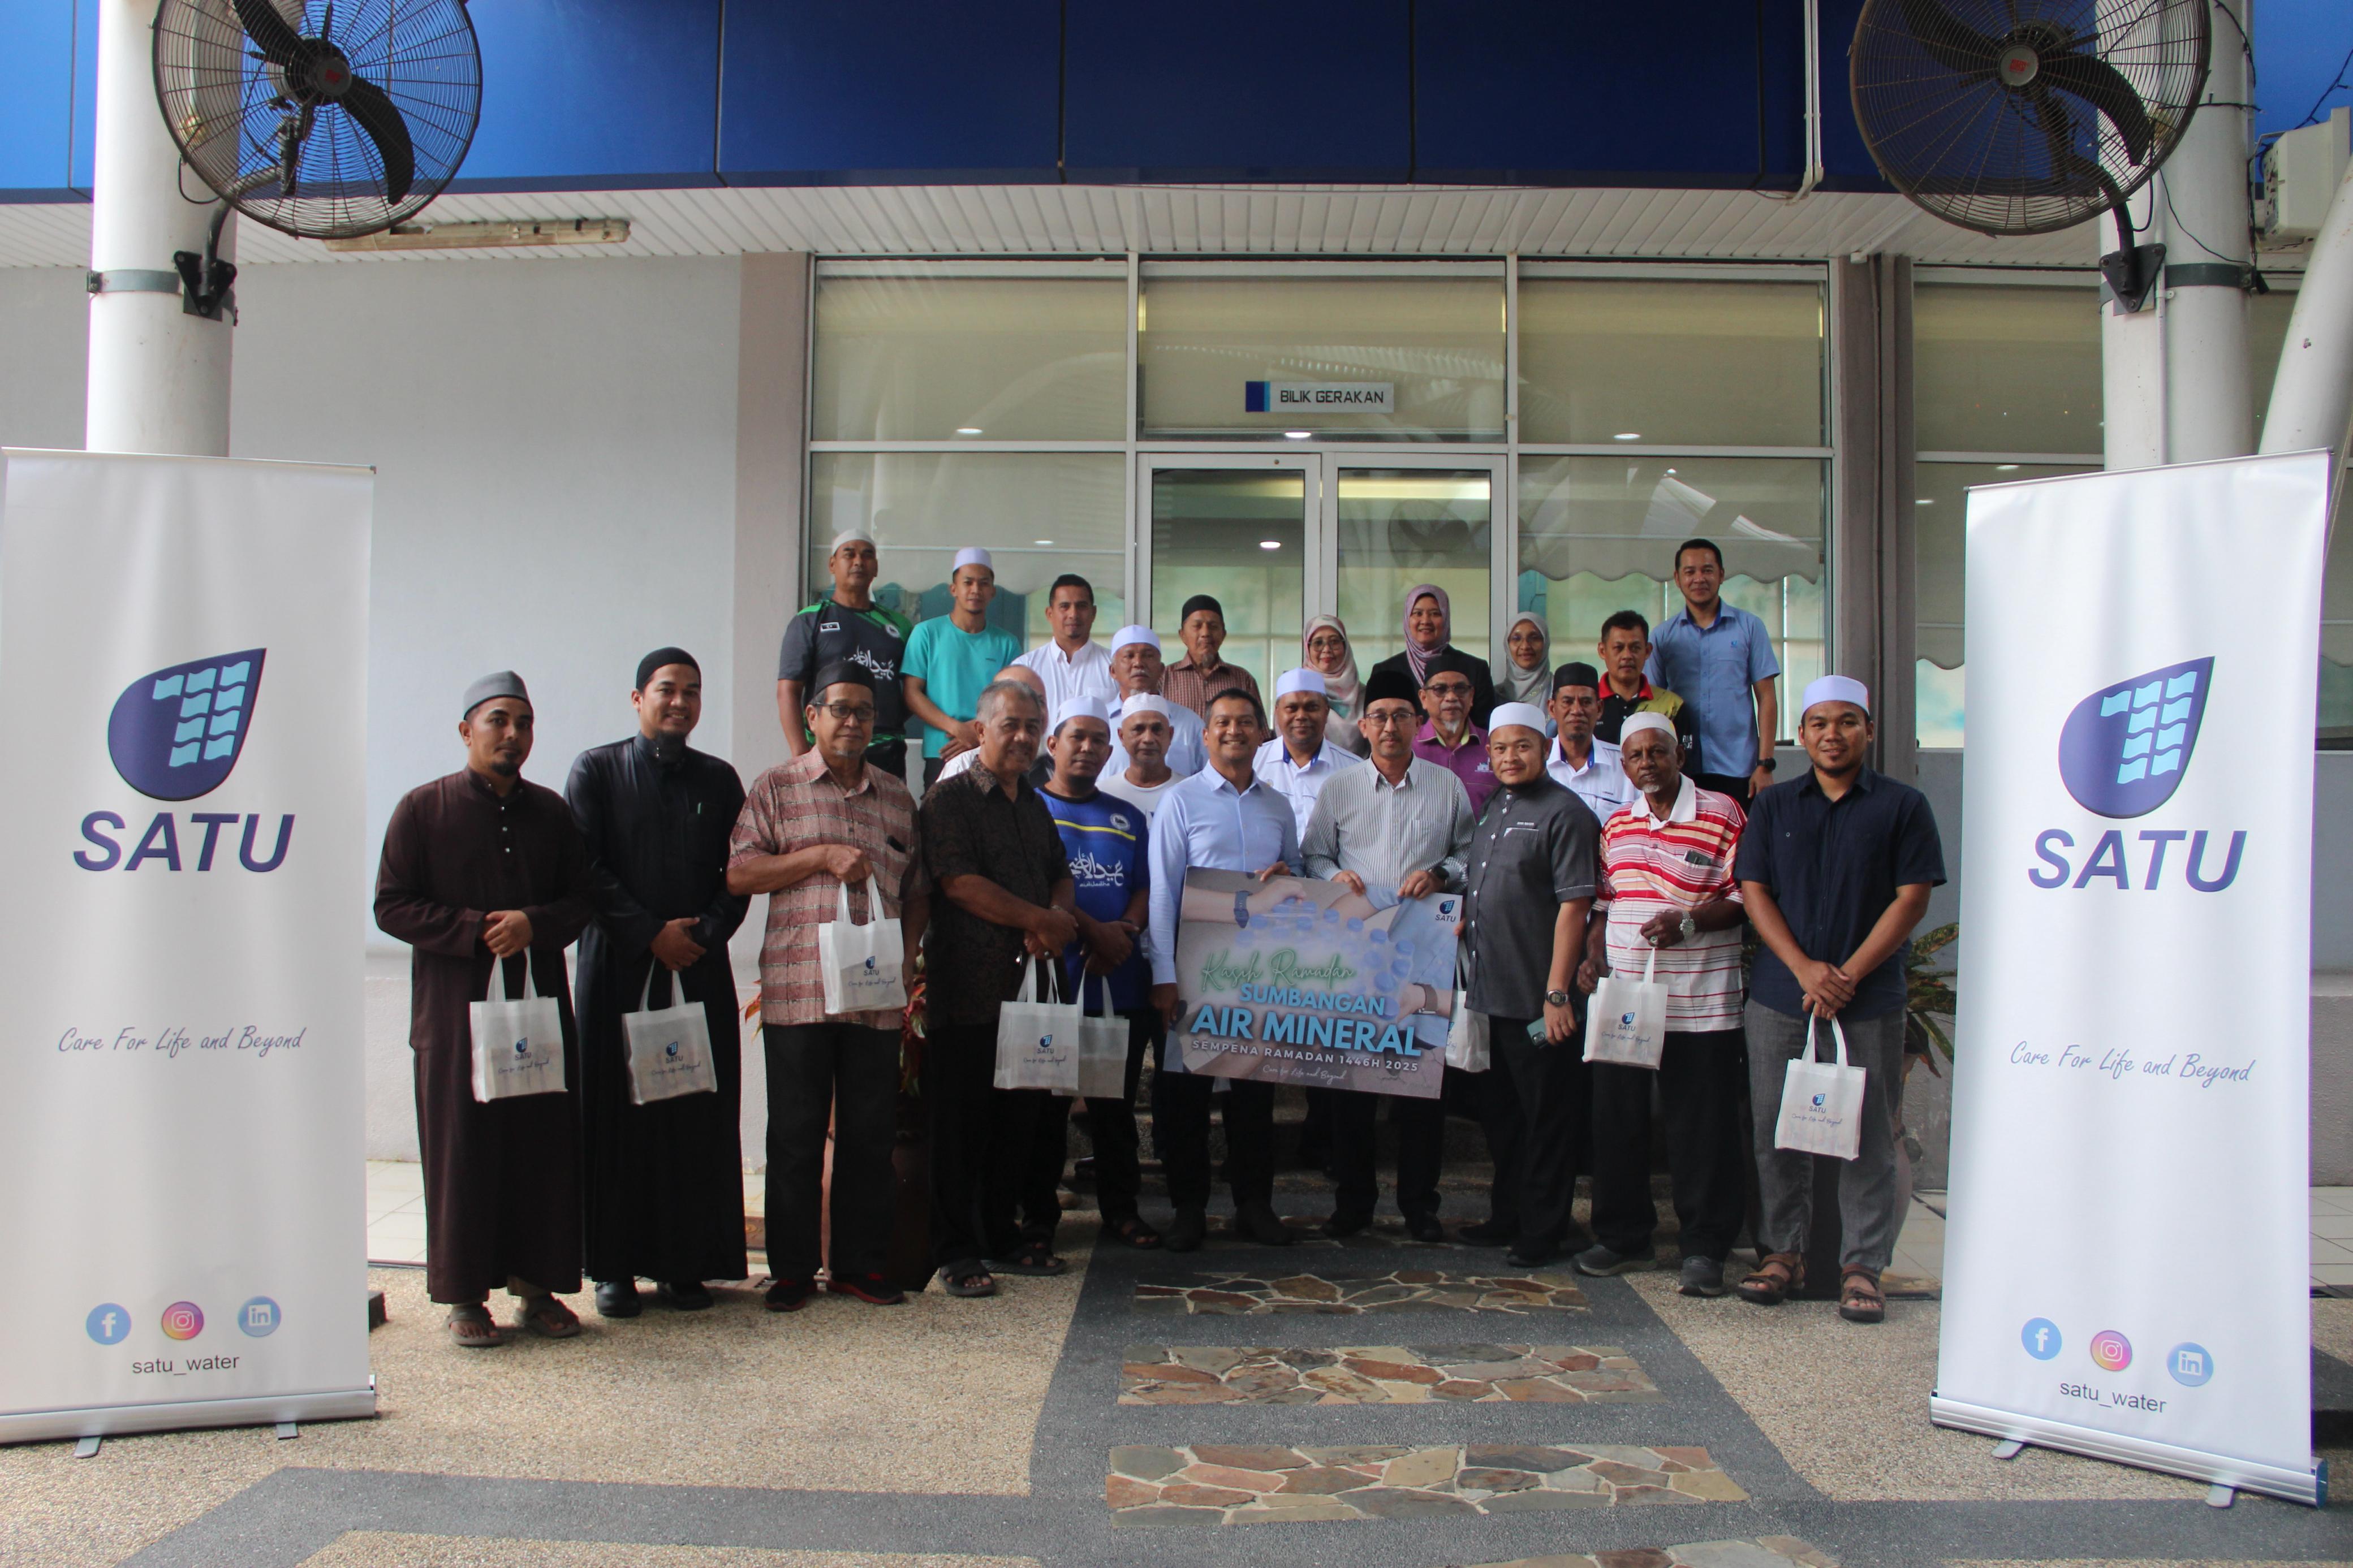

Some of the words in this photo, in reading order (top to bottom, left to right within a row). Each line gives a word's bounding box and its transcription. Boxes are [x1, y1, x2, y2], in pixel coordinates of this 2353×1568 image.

[1280, 390, 1312, 403] BILIK
[1316, 390, 1384, 403] GERAKAN
[73, 810, 296, 873] SATU
[2028, 828, 2248, 893] SATU
[1435, 914, 1456, 922] SATU
[1202, 949, 1262, 991] Kasih
[1270, 949, 1355, 990] Ramadan
[1239, 983, 1385, 1016] SUMBANGAN
[58, 1027, 104, 1052] Care
[113, 1026, 148, 1051] For
[156, 1027, 191, 1059] Life
[200, 1027, 233, 1050] and
[238, 1025, 307, 1058] Beyond
[1190, 1004, 1253, 1040] AIR
[1262, 1010, 1421, 1057] MINERAL
[1192, 1040, 1259, 1055] SEMPENA
[1264, 1047, 1334, 1063] RAMADAN
[1339, 1055, 1381, 1068] 1446H
[1385, 1060, 1419, 1072] 2025
[2010, 1040, 2050, 1065] Care
[2058, 1044, 2092, 1068] For
[2098, 1048, 2135, 1080] Life
[2143, 1054, 2176, 1075] and
[2179, 1053, 2256, 1088] Beyond
[132, 1355, 240, 1376] satu_water
[2059, 1382, 2167, 1413] satu_water
